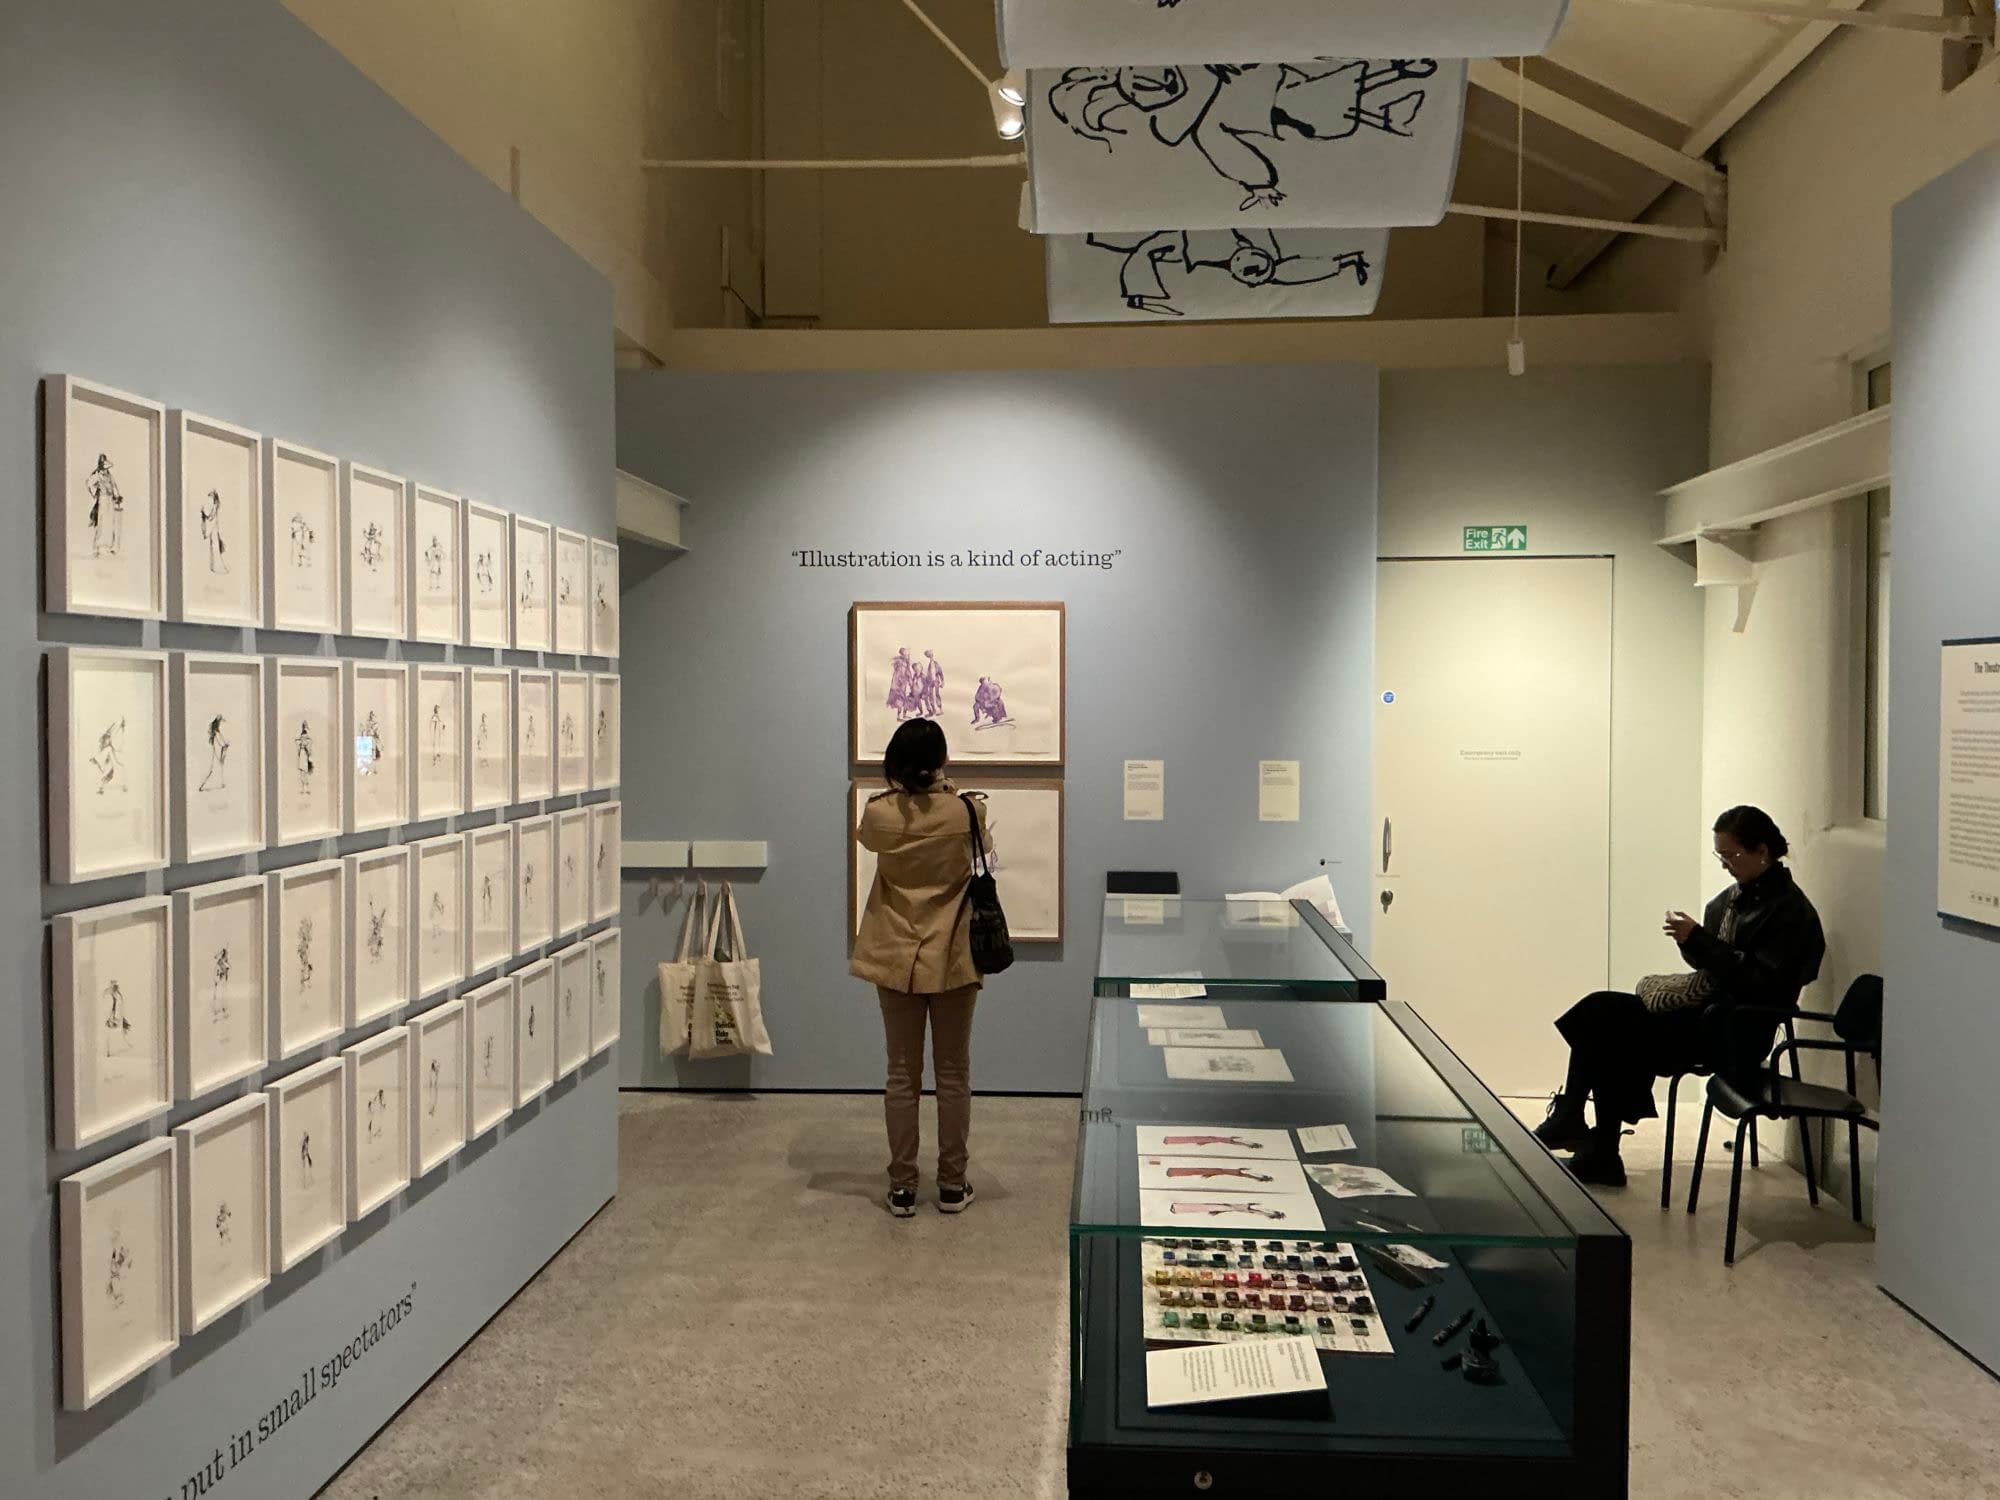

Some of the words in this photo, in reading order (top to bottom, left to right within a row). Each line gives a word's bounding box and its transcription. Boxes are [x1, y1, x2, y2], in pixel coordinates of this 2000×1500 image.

[1466, 528, 1488, 539] Fire
[1465, 539, 1489, 550] Exit
[791, 550, 922, 567] “Illustration
[927, 550, 945, 567] is
[950, 554, 963, 567] a
[967, 550, 1014, 567] kind
[1020, 549, 1042, 567] of
[1045, 549, 1122, 570] acting”
[229, 1428, 254, 1469] in
[258, 1366, 317, 1444] small
